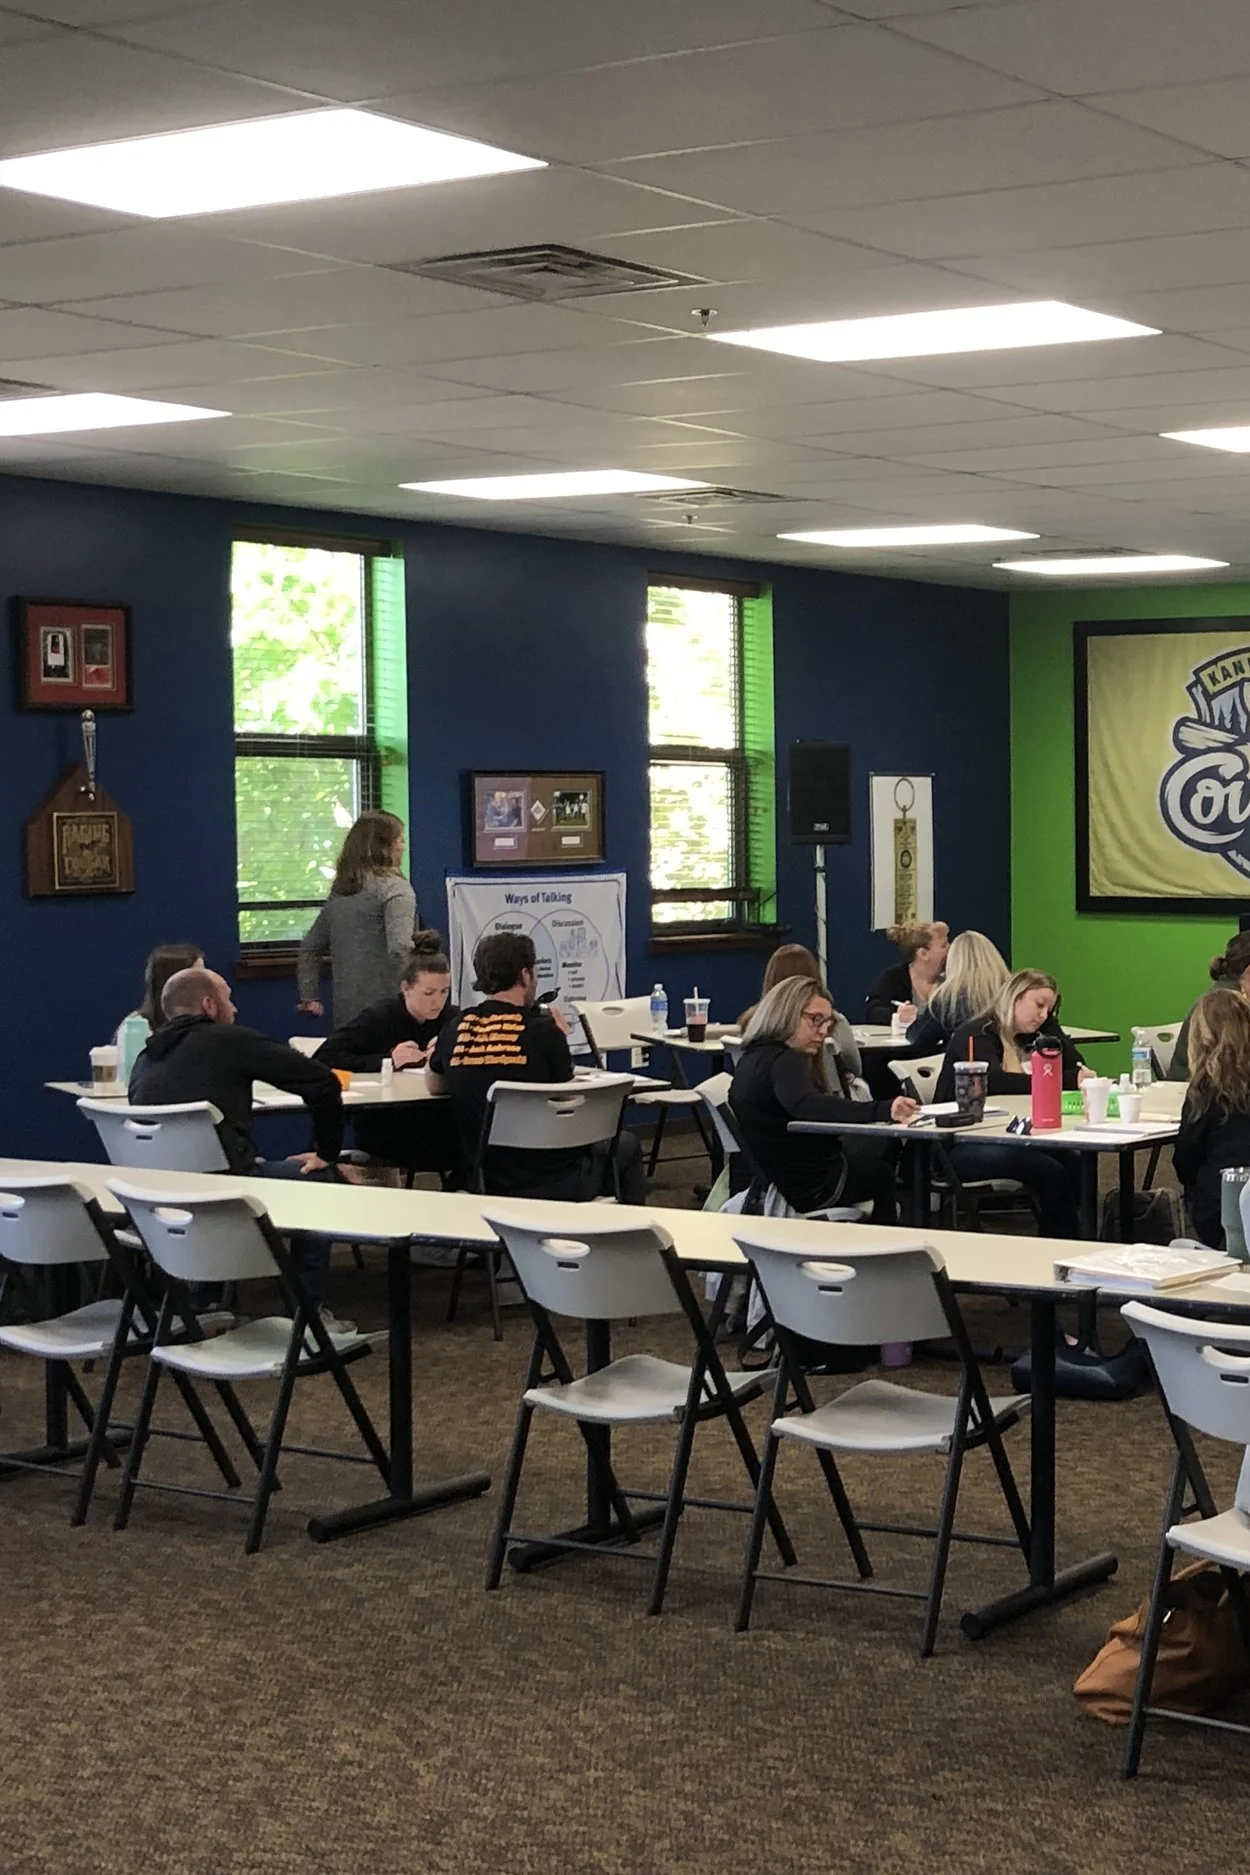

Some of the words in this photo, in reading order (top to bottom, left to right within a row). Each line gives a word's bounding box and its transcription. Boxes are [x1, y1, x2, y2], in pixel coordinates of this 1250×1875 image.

[504, 892, 529, 906] Ways
[530, 892, 541, 904] of
[541, 891, 573, 905] Talking
